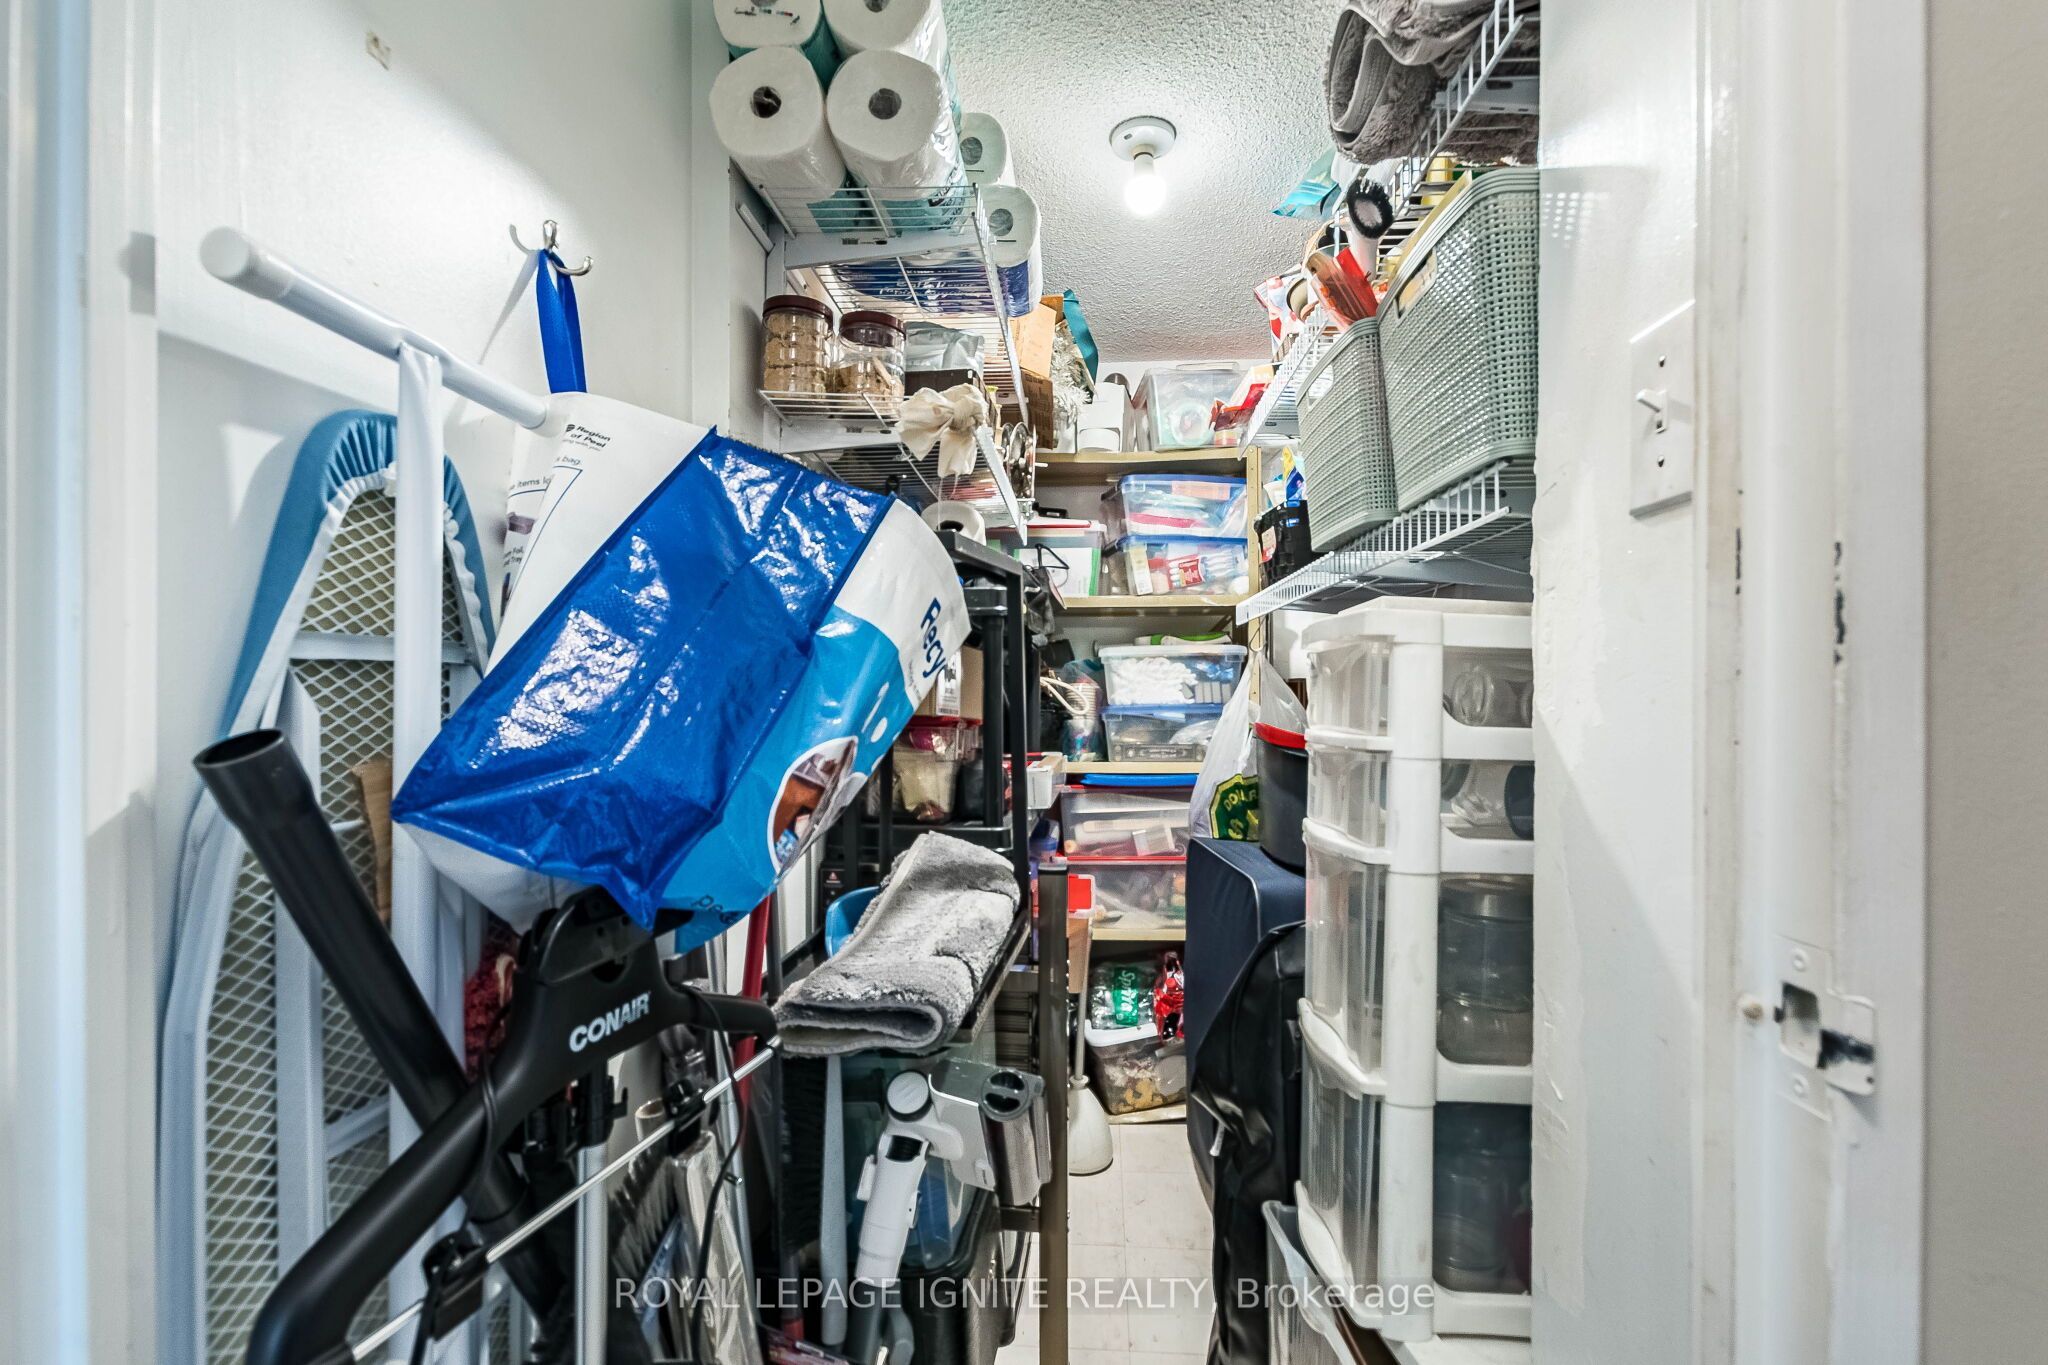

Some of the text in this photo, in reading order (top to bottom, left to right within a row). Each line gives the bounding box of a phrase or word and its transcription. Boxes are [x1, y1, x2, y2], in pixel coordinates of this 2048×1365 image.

[576, 426, 611, 441] Region
[583, 437, 606, 448] Peel
[569, 992, 650, 1052] CONAIR
